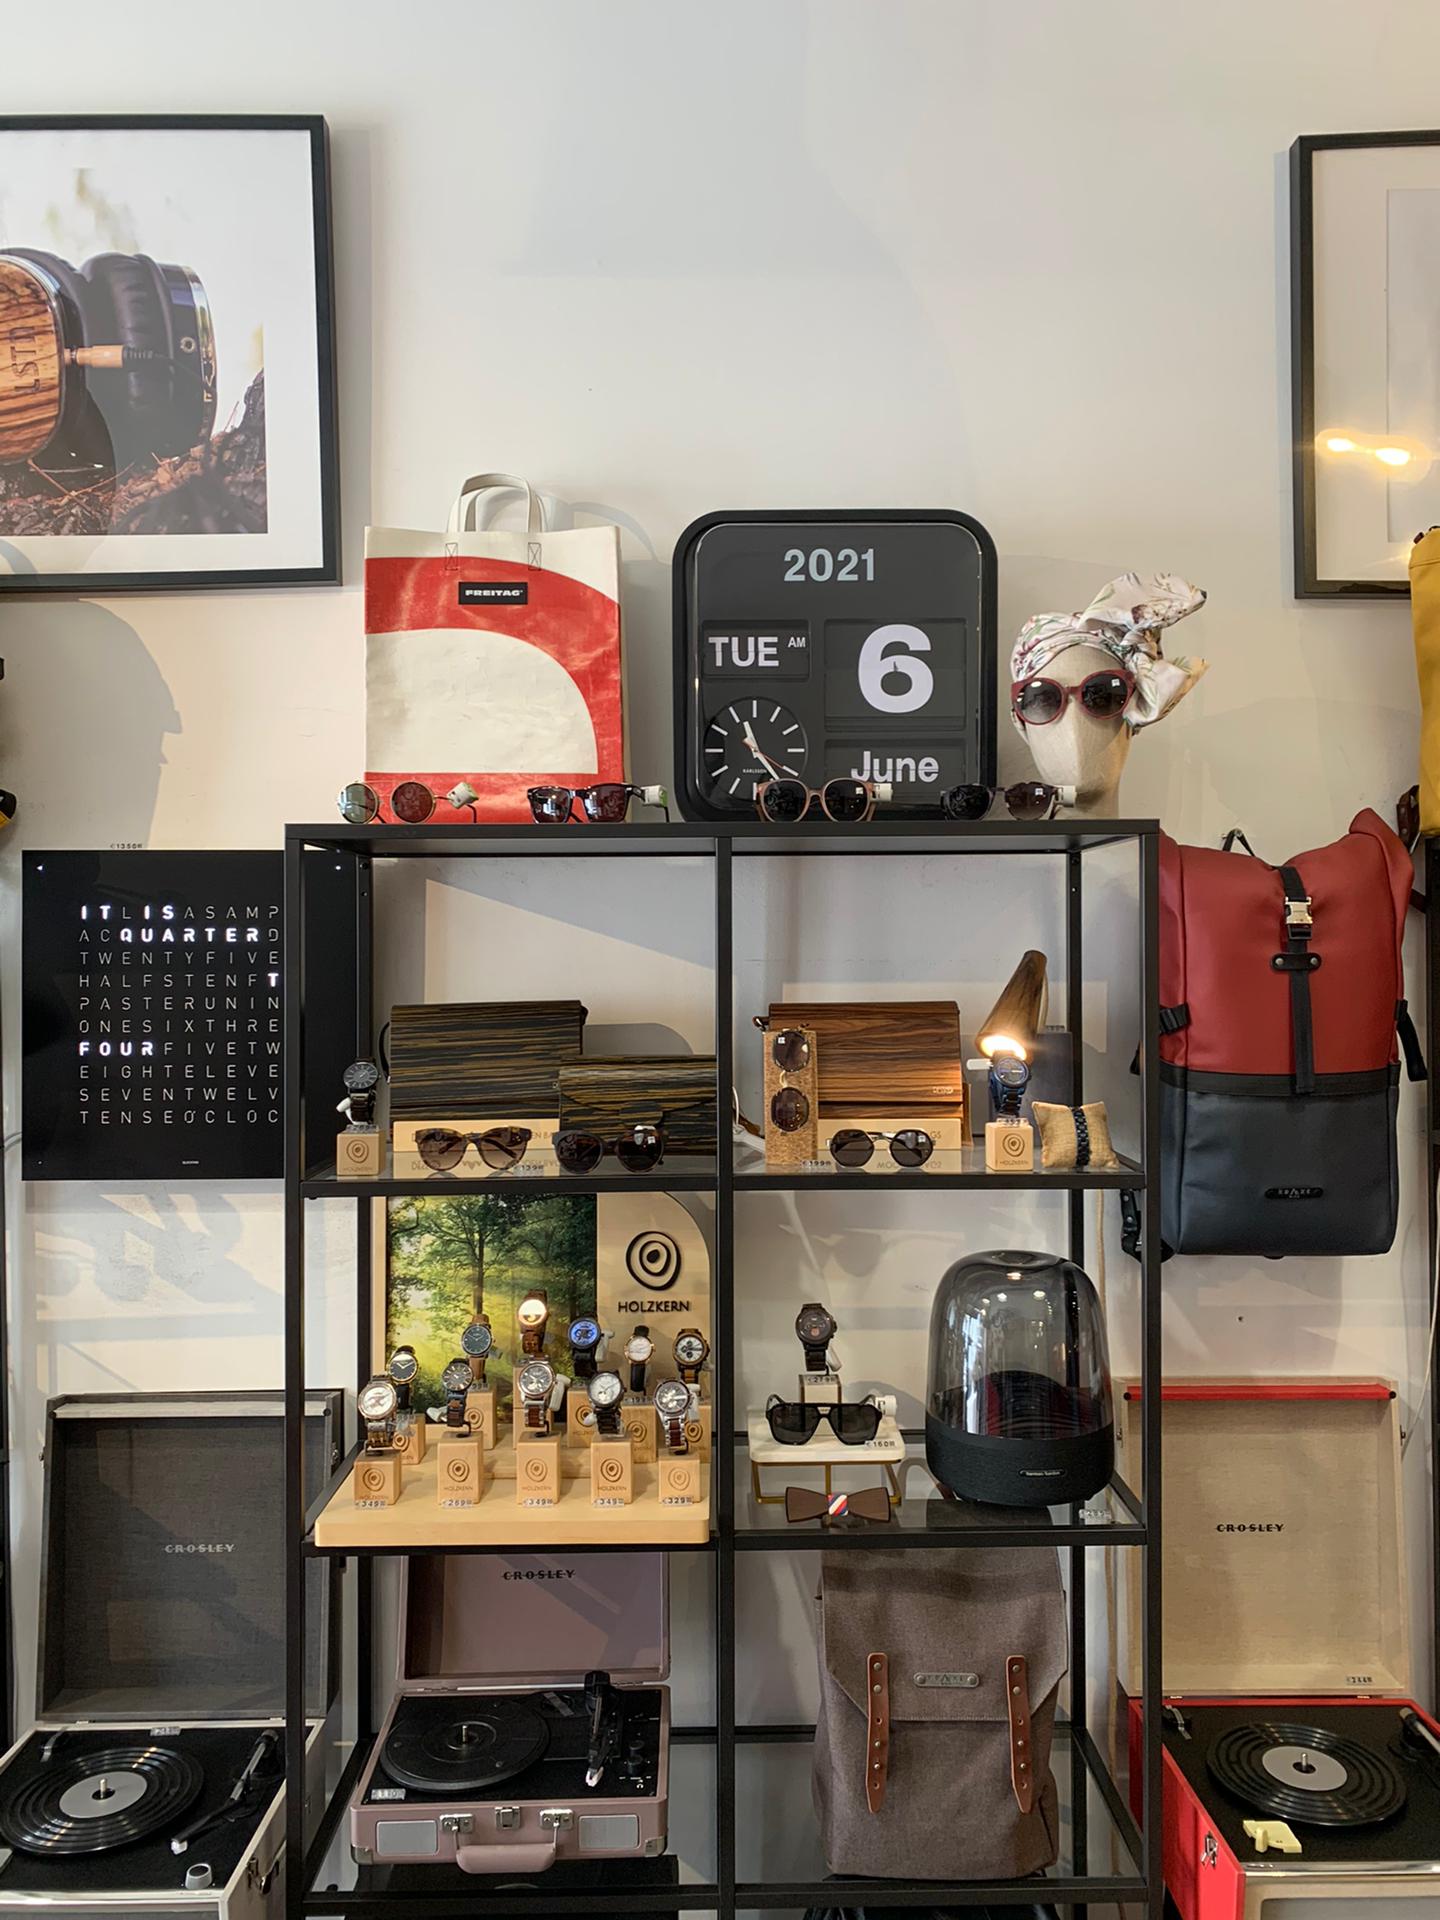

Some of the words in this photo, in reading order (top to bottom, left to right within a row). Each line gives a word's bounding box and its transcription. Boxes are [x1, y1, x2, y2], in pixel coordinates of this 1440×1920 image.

[783, 548, 876, 582] 2021
[465, 589, 522, 597] FREITAG
[708, 636, 780, 667] TUE
[787, 637, 806, 648] AM
[858, 623, 934, 714] 6
[851, 751, 940, 783] June
[617, 1300, 691, 1313] HOLZKERN
[1216, 1523, 1284, 1532] CROSLEY
[164, 1543, 236, 1554] CROSLEY
[503, 1569, 575, 1581] CROSLEY
